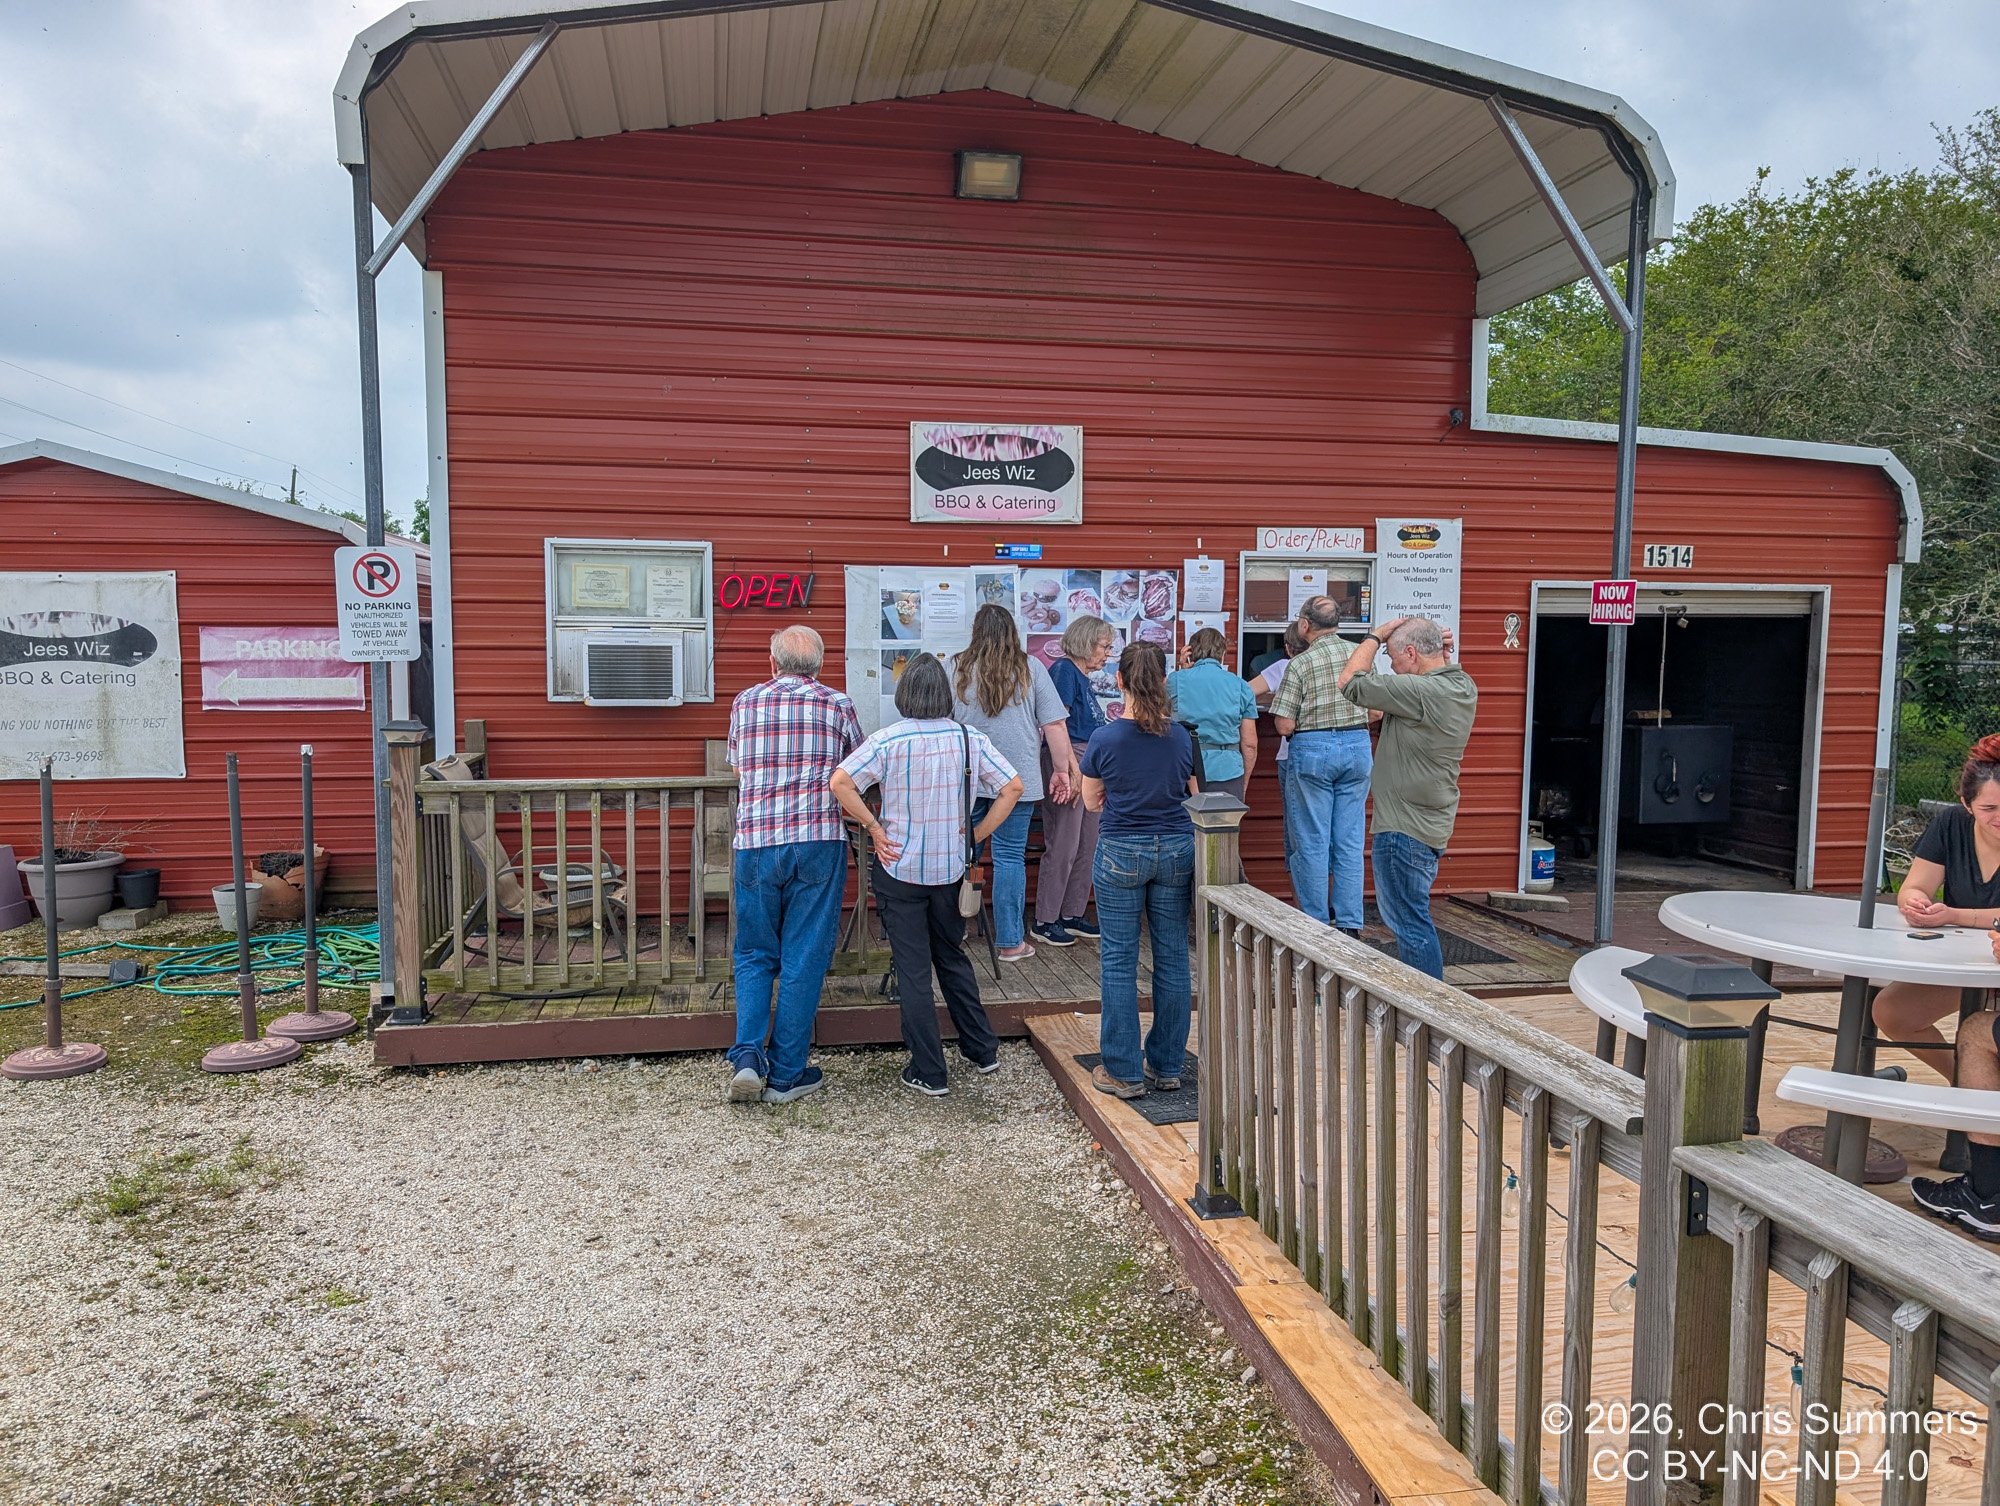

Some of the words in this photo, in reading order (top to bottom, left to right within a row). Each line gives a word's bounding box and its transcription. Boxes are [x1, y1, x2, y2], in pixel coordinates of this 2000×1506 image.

[962, 465, 1000, 480] Jees
[1005, 465, 1035, 480] Wiz
[935, 495, 970, 509] BBQ
[976, 496, 986, 509] &
[992, 495, 1056, 513] Catering
[1419, 552, 1453, 561] Operation
[1647, 546, 1691, 567] 1514
[1412, 566, 1438, 575] Monday
[720, 574, 815, 608] OPEN
[1413, 591, 1432, 599] Open
[1599, 585, 1629, 600] NOW
[345, 602, 360, 611] NO
[365, 602, 412, 611] PARKING
[1386, 603, 1408, 611] Friday
[1592, 603, 1632, 620] HIRING
[352, 630, 382, 638] TOWED
[385, 629, 407, 638] AWAY
[23, 641, 69, 656] Jees
[74, 641, 111, 656] Wiz
[41, 671, 54, 685] &
[60, 671, 136, 688] Catering
[20, 719, 41, 730] YOU
[44, 719, 93, 730] NOTHING
[143, 717, 168, 729] BEST
